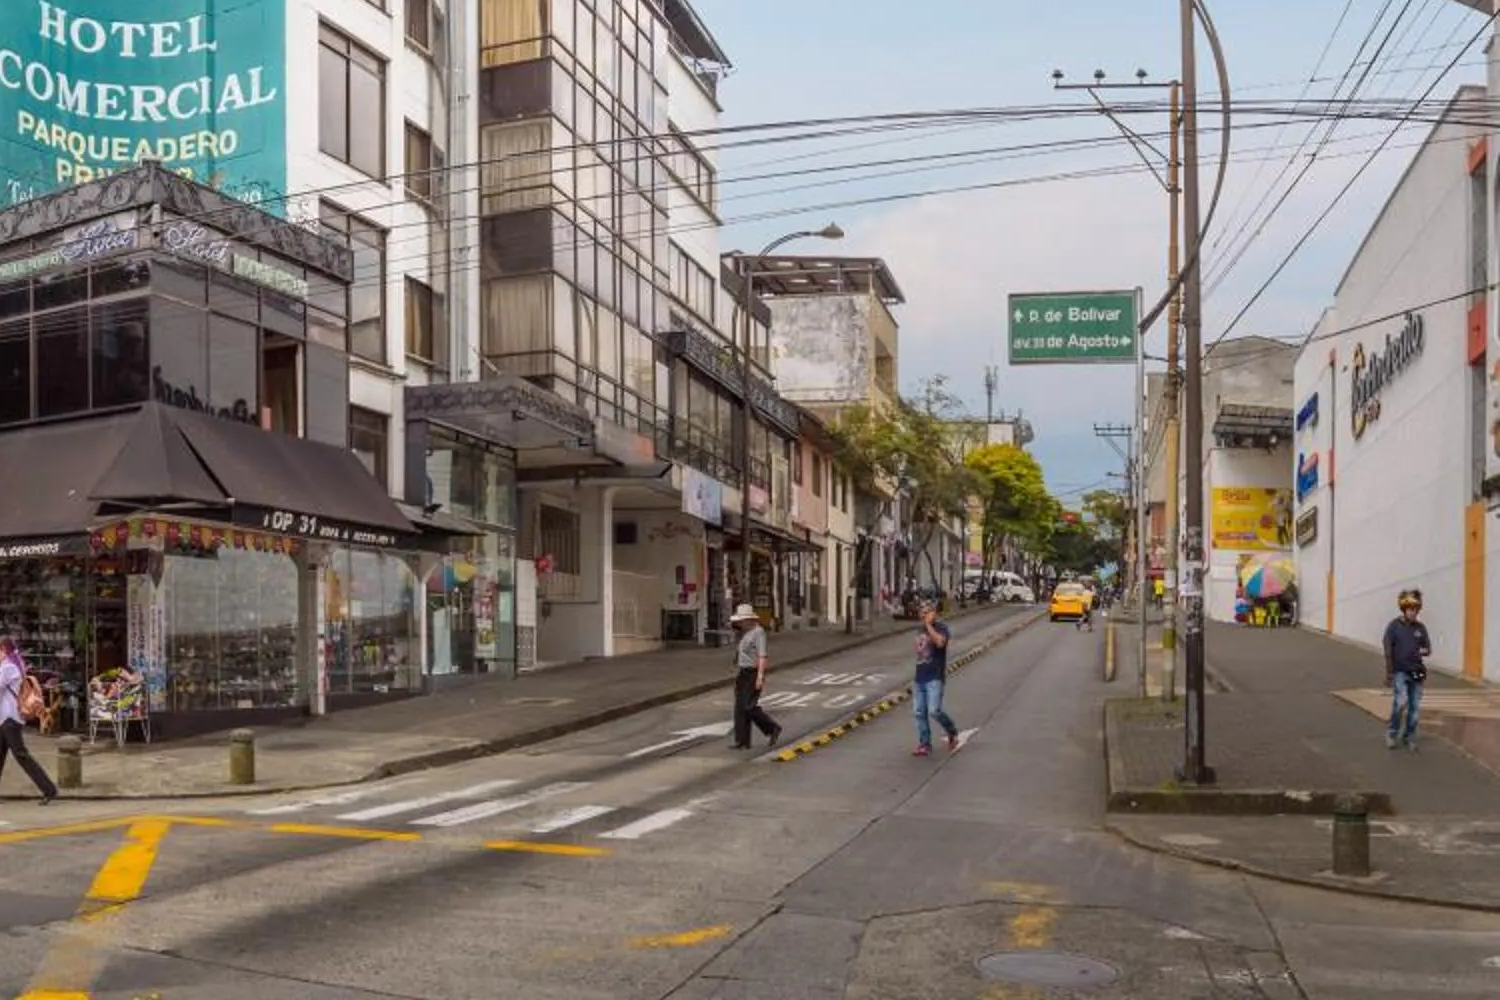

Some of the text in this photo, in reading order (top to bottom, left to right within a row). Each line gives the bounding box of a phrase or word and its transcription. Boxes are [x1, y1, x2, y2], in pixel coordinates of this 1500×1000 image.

[38, 0, 218, 57] HOTEL
[17, 110, 238, 163] PARQUEADERO
[1044, 308, 1063, 322] de
[1047, 335, 1063, 349] de
[1067, 334, 1120, 351] Agosto
